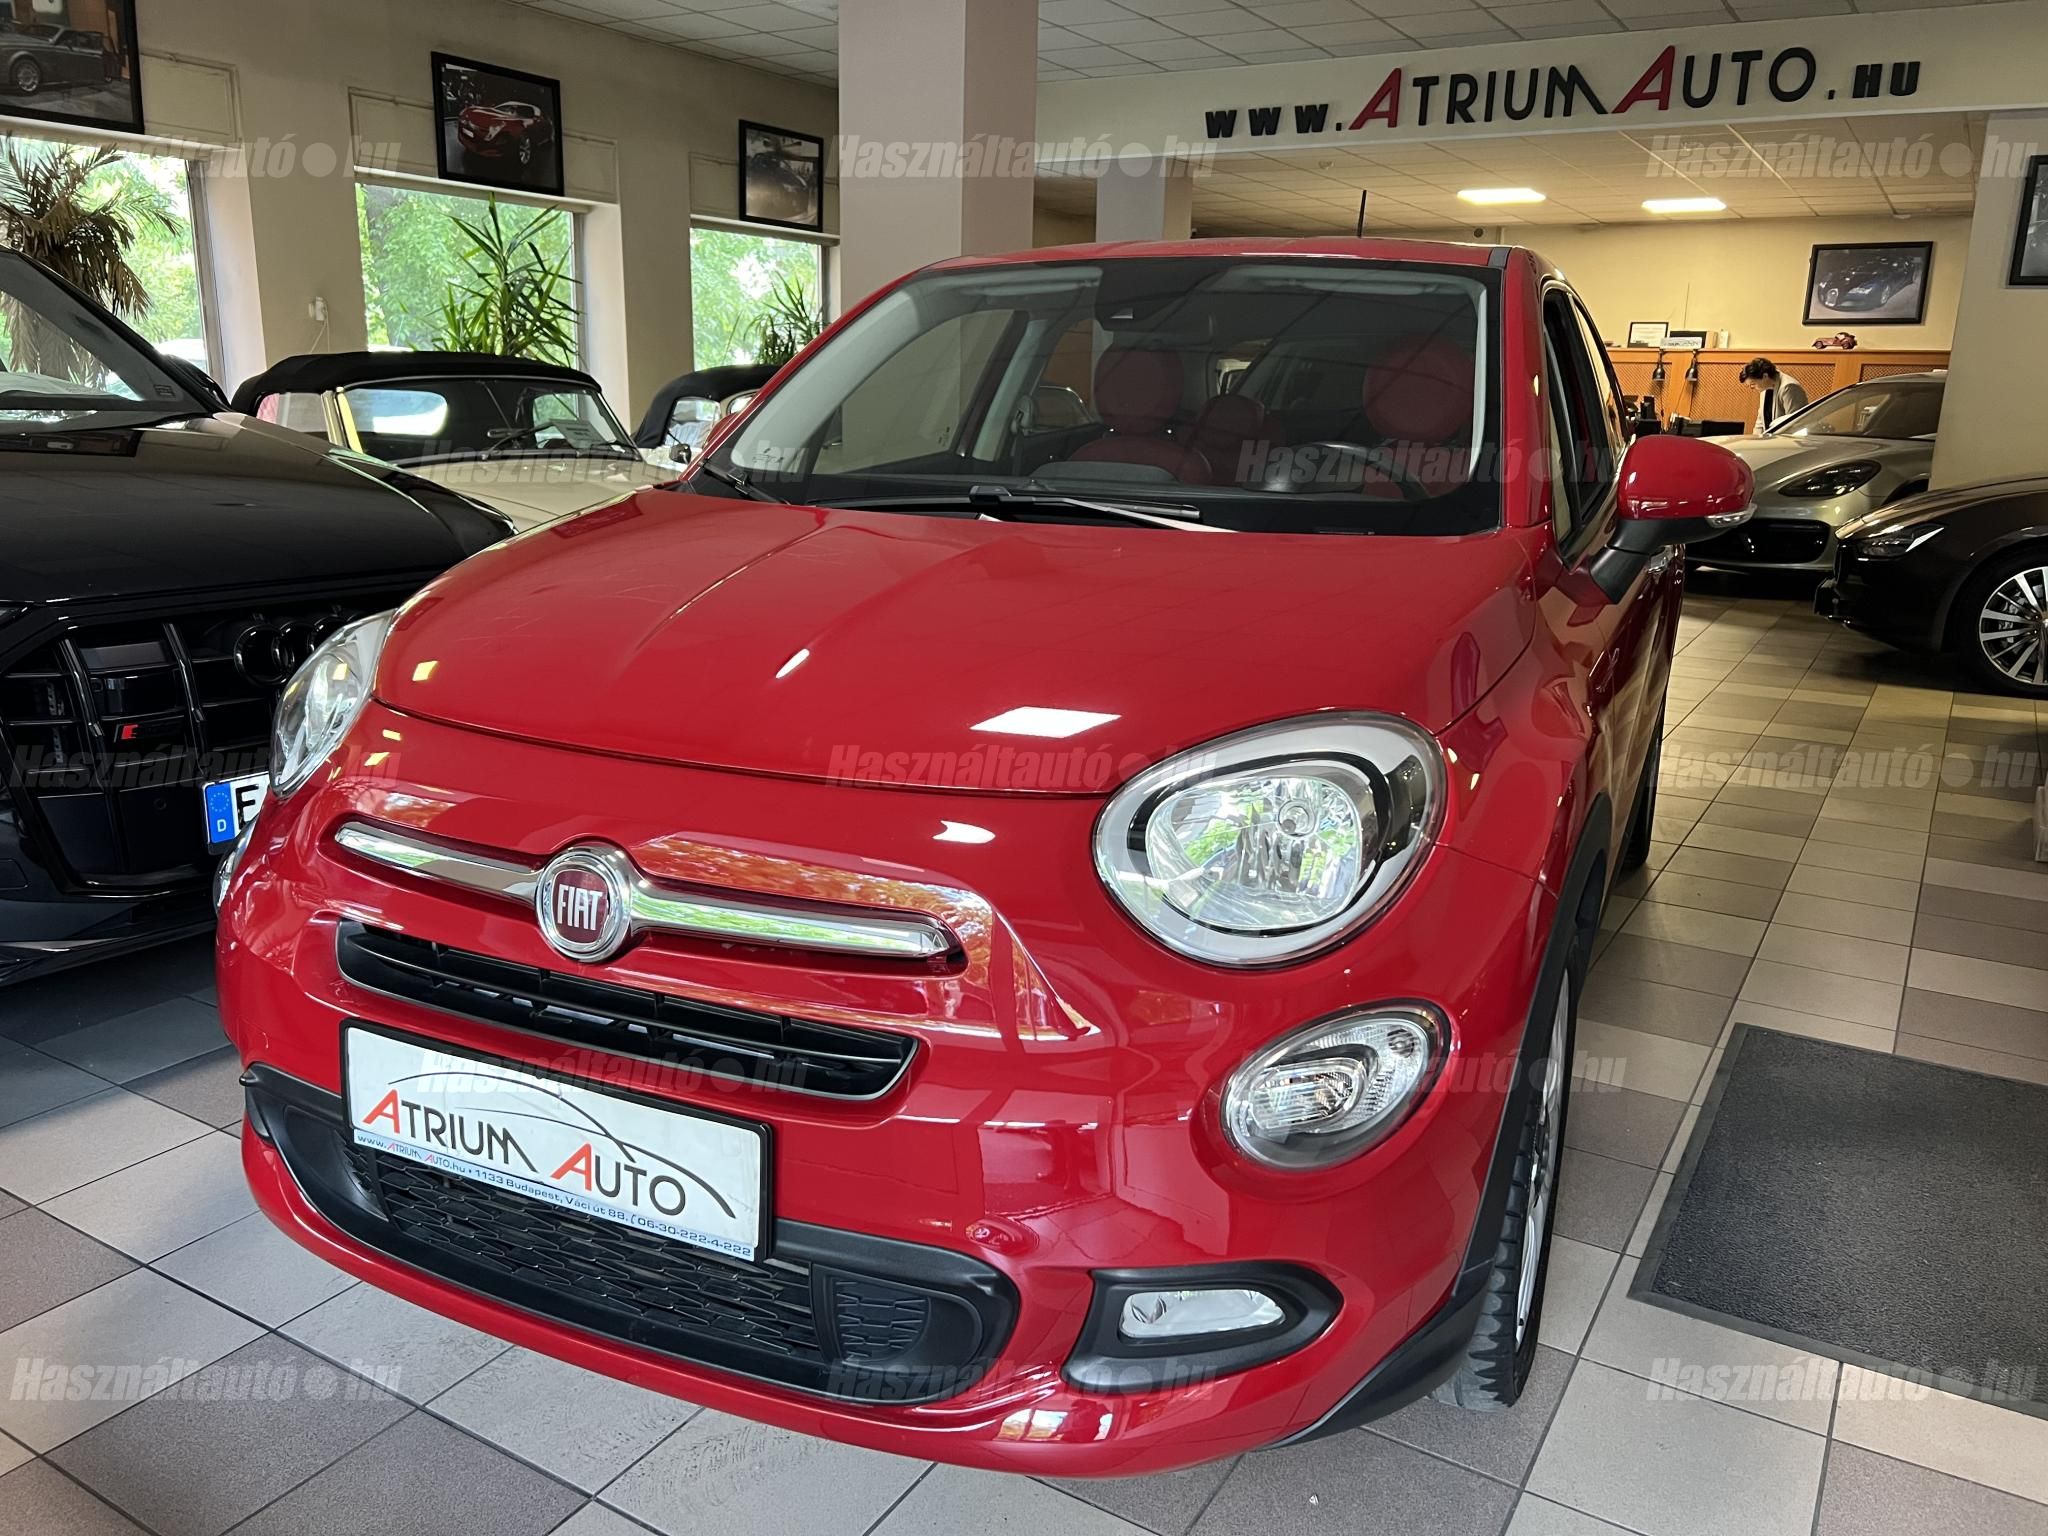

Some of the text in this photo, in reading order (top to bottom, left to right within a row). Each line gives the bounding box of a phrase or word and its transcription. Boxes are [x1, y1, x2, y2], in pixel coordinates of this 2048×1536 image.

[216, 818, 227, 832] D
[557, 883, 603, 931] FIAT
[362, 1088, 687, 1217] ATRIUM AUTO
[475, 1169, 504, 1185] 1133
[506, 1178, 564, 1204] Budapest,
